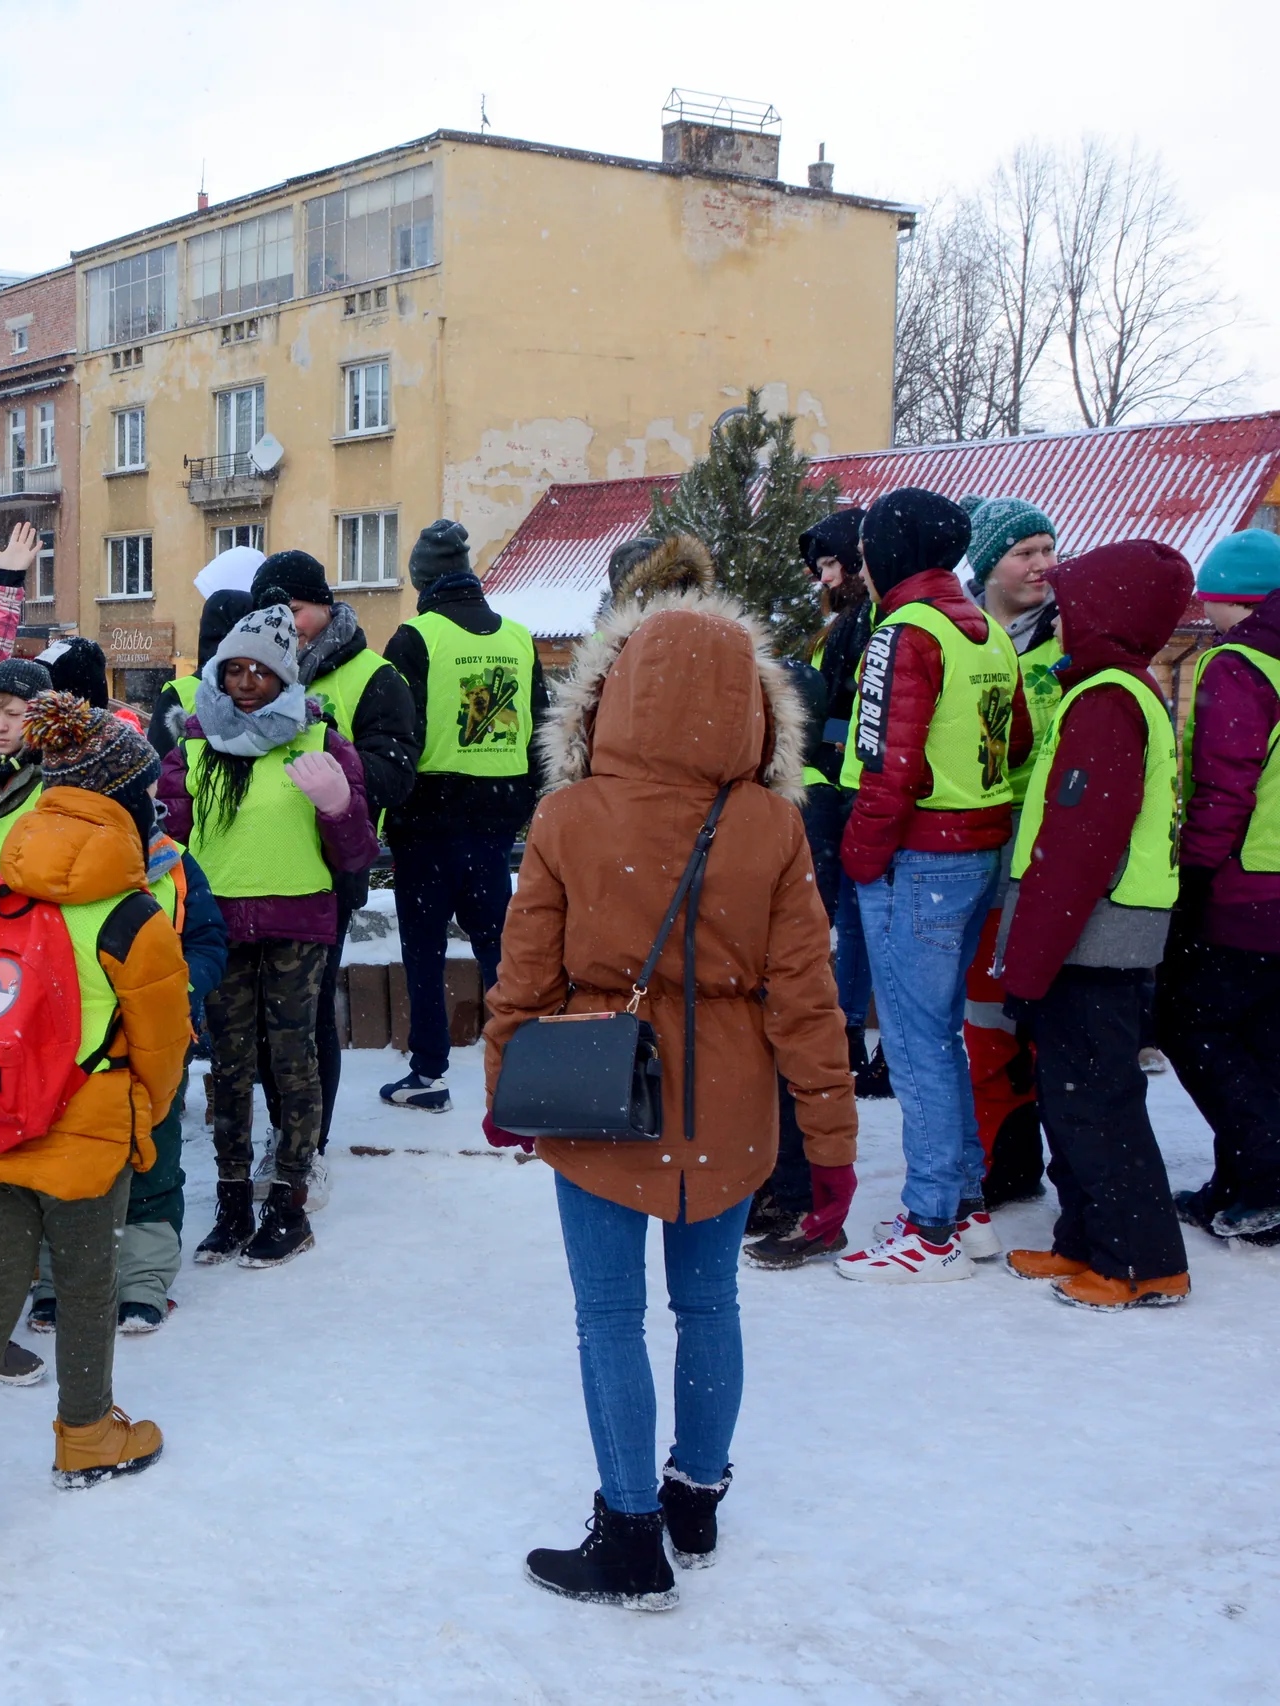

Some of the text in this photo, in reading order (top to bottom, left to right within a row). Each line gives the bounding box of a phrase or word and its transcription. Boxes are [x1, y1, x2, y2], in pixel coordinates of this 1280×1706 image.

[110, 627, 153, 650] Bistro
[455, 655, 519, 665] OBOZY ZIMOWE
[858, 698, 882, 757] BLUE
[941, 1249, 962, 1267] FILA
